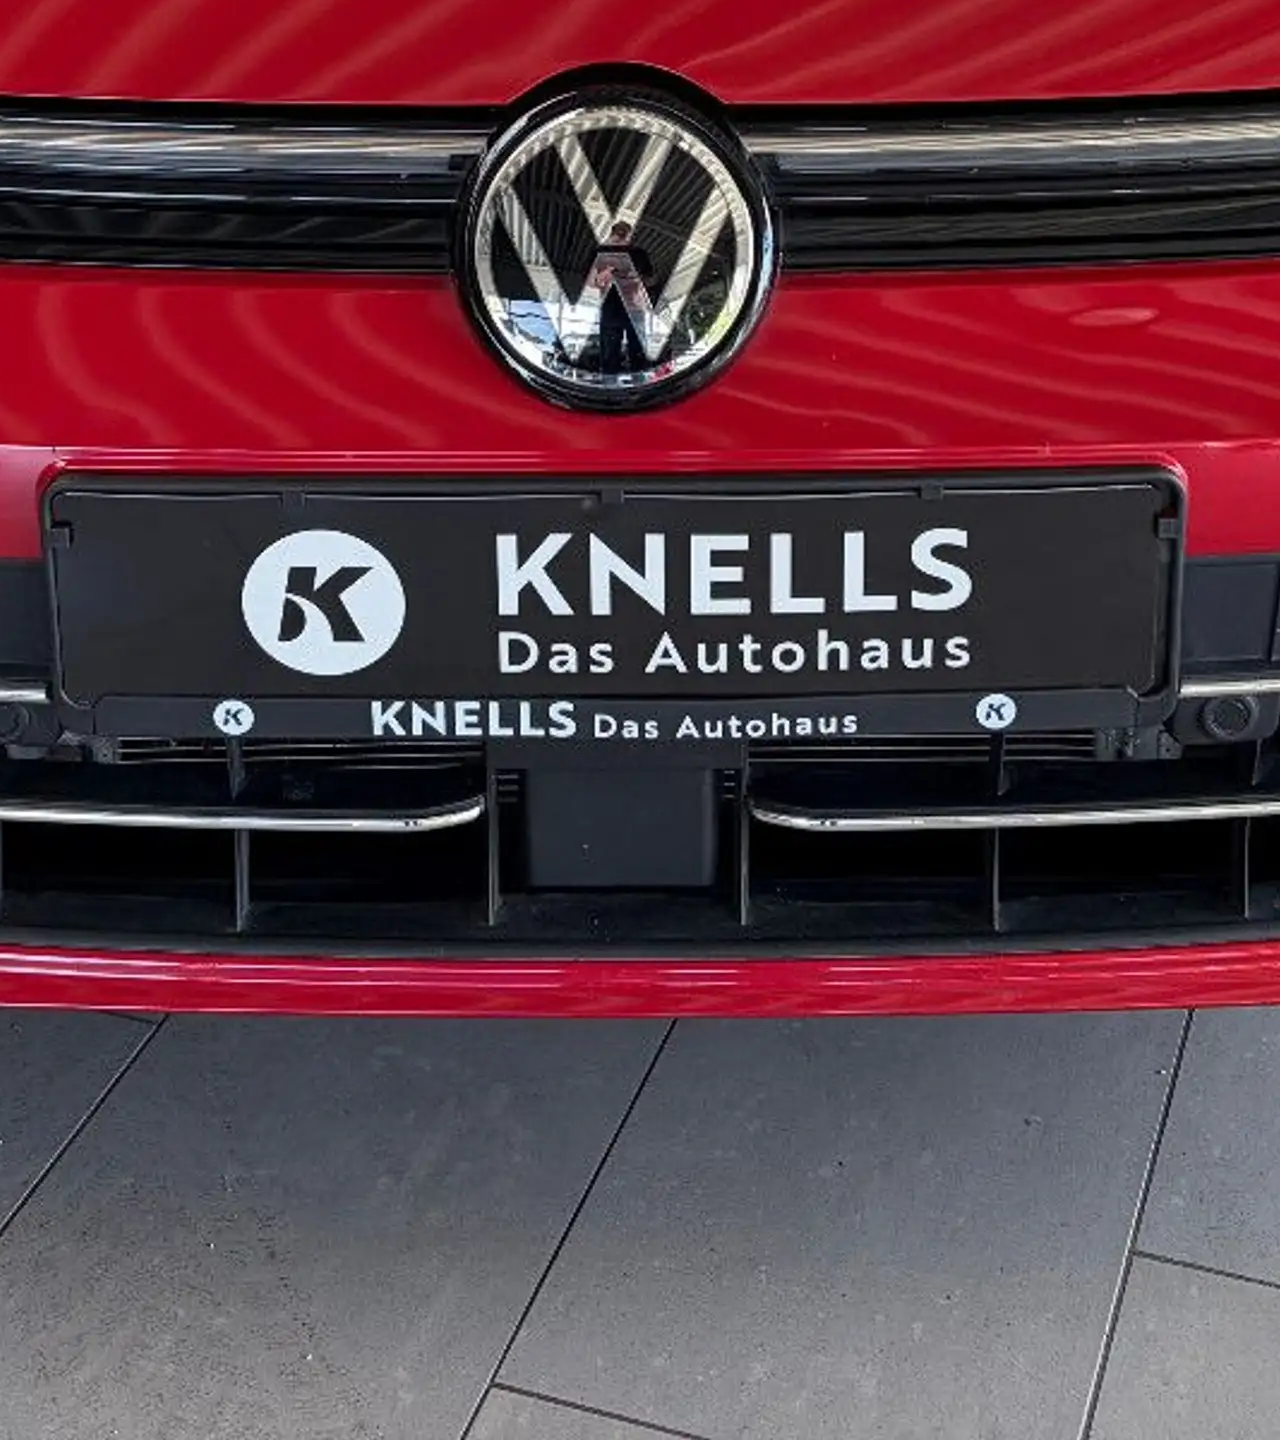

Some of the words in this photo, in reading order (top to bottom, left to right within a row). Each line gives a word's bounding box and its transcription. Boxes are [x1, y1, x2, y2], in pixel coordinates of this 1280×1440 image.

[495, 527, 973, 616] KNELLS
[277, 566, 374, 642] K
[498, 631, 614, 674] Das
[644, 629, 970, 673] Autohaus
[371, 700, 577, 738] KNELLS
[594, 713, 659, 739] Das
[675, 712, 858, 739] Autohaus
